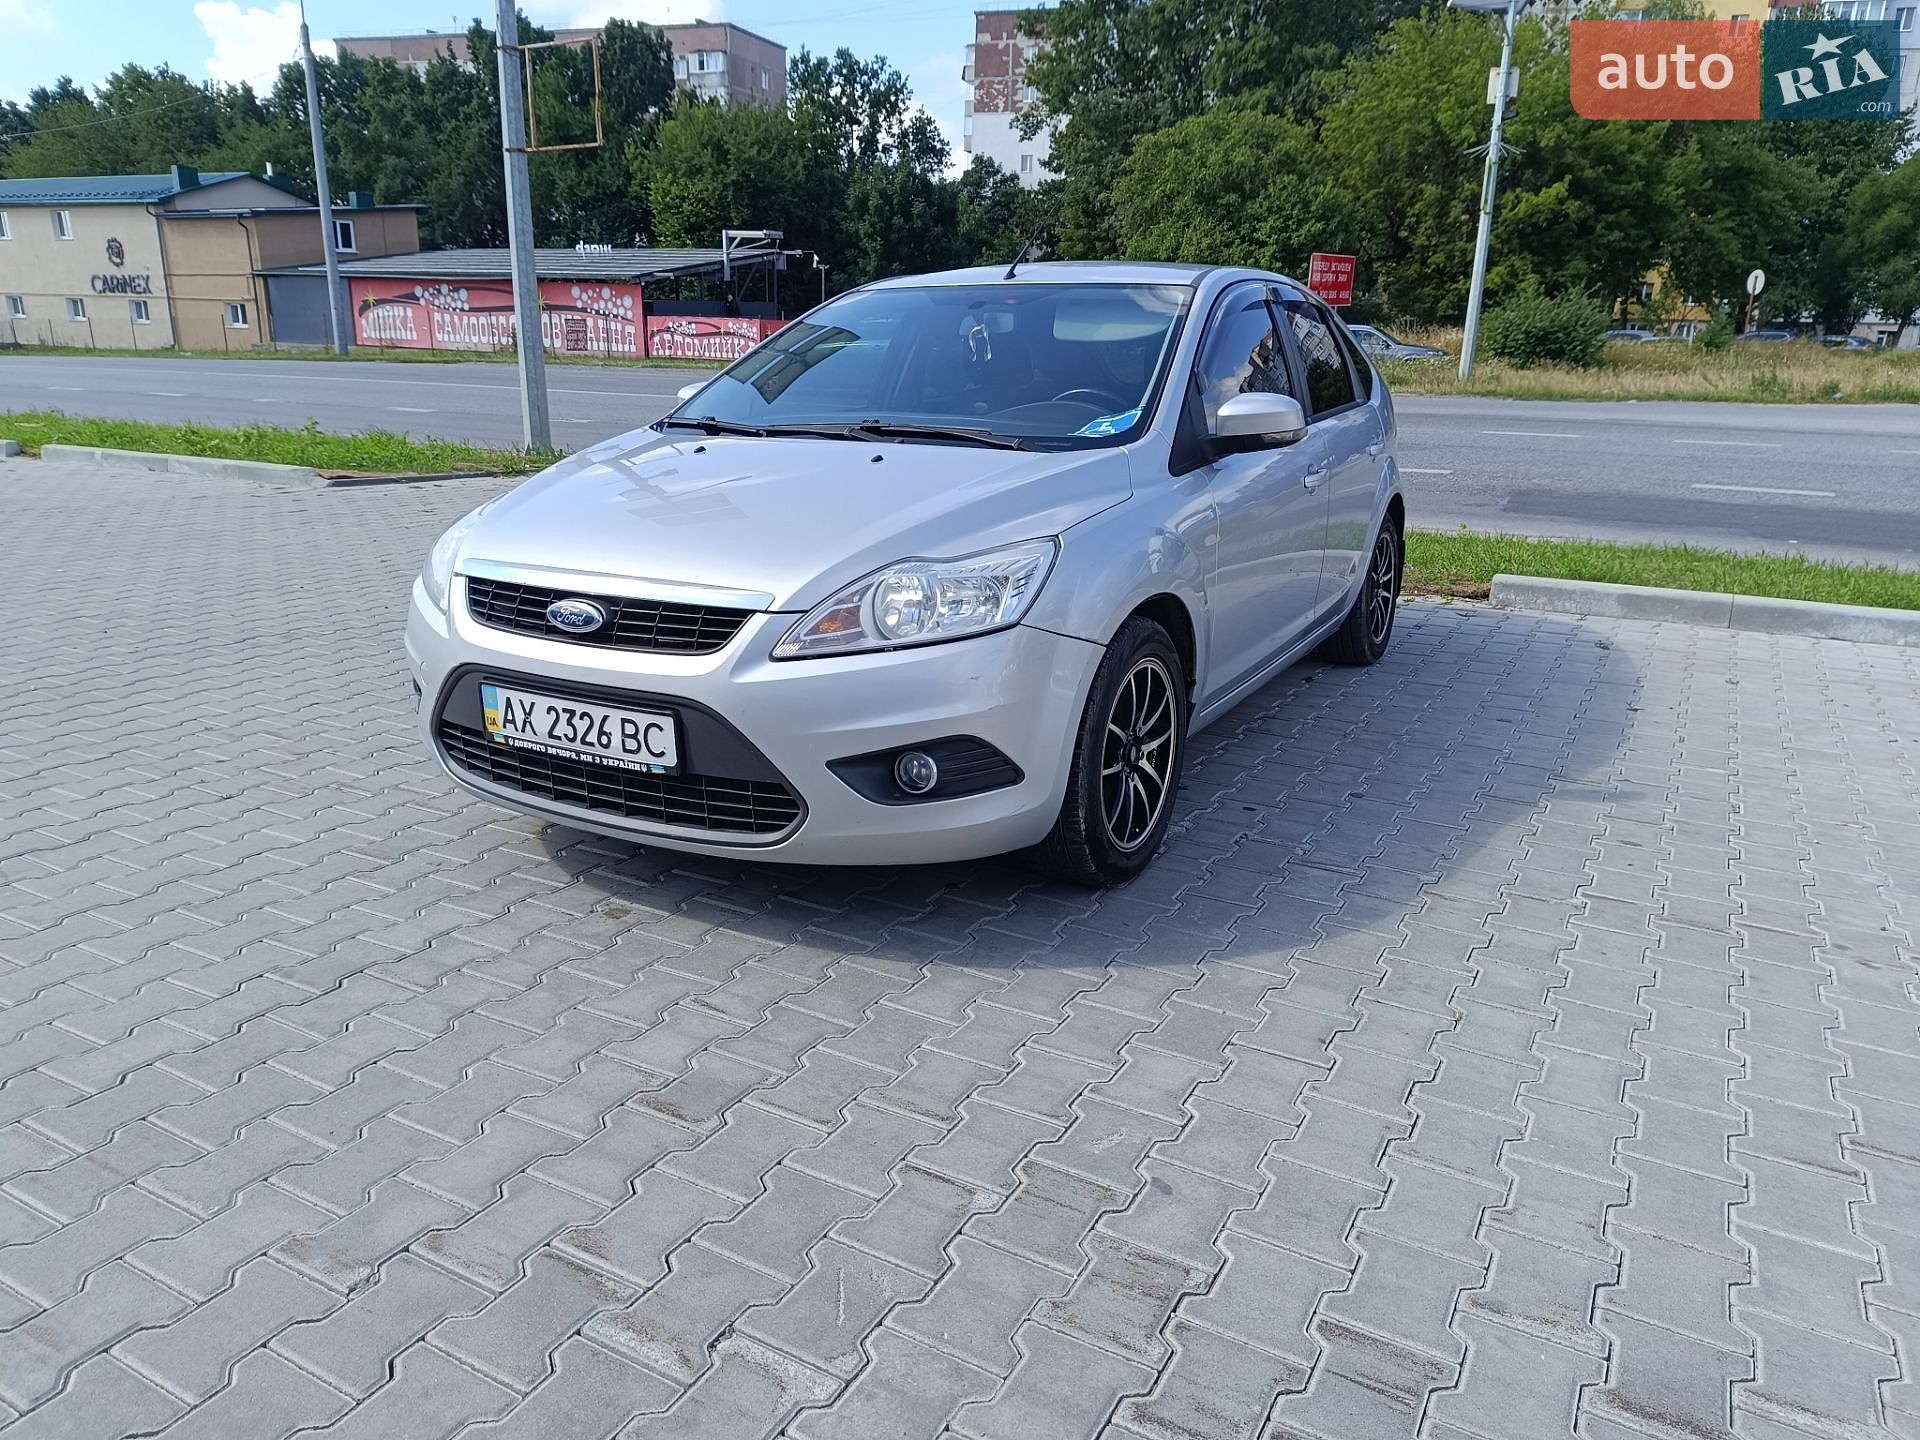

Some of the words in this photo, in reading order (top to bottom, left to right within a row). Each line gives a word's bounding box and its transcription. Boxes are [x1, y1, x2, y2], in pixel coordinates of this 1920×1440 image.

[557, 606, 587, 625] Ford
[486, 716, 498, 726] UA
[503, 696, 538, 736] AX
[546, 705, 612, 749] 2326
[621, 717, 666, 758] BC
